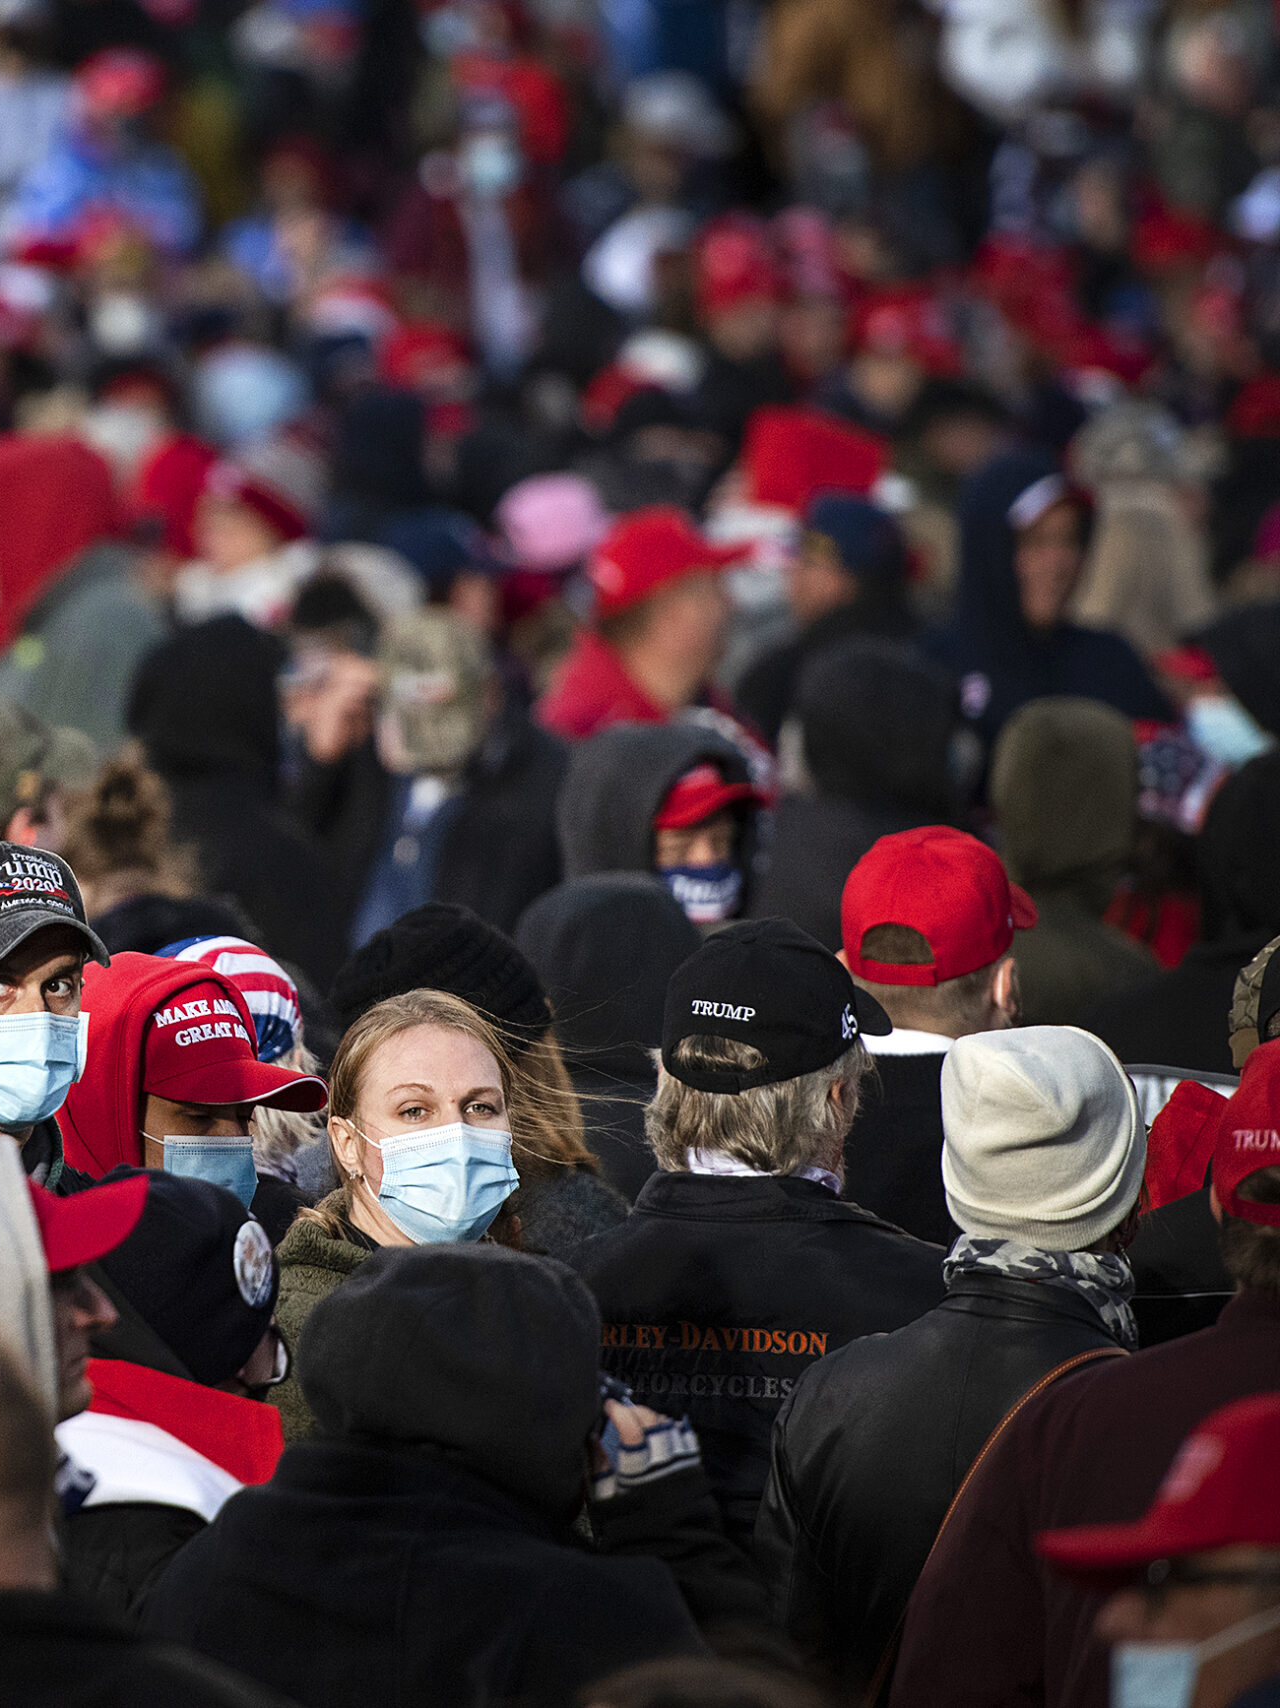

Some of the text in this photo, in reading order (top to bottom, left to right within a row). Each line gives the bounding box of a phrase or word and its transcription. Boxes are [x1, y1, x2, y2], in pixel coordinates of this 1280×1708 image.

[11, 877, 55, 893] 2020
[153, 999, 212, 1029] MAKE
[692, 1000, 756, 1022] TRUMP
[841, 1003, 858, 1040] 45
[175, 1021, 233, 1047] GREAT
[1232, 1129, 1280, 1152] TRUM
[602, 1320, 830, 1357] RLEY-DAVIDSON
